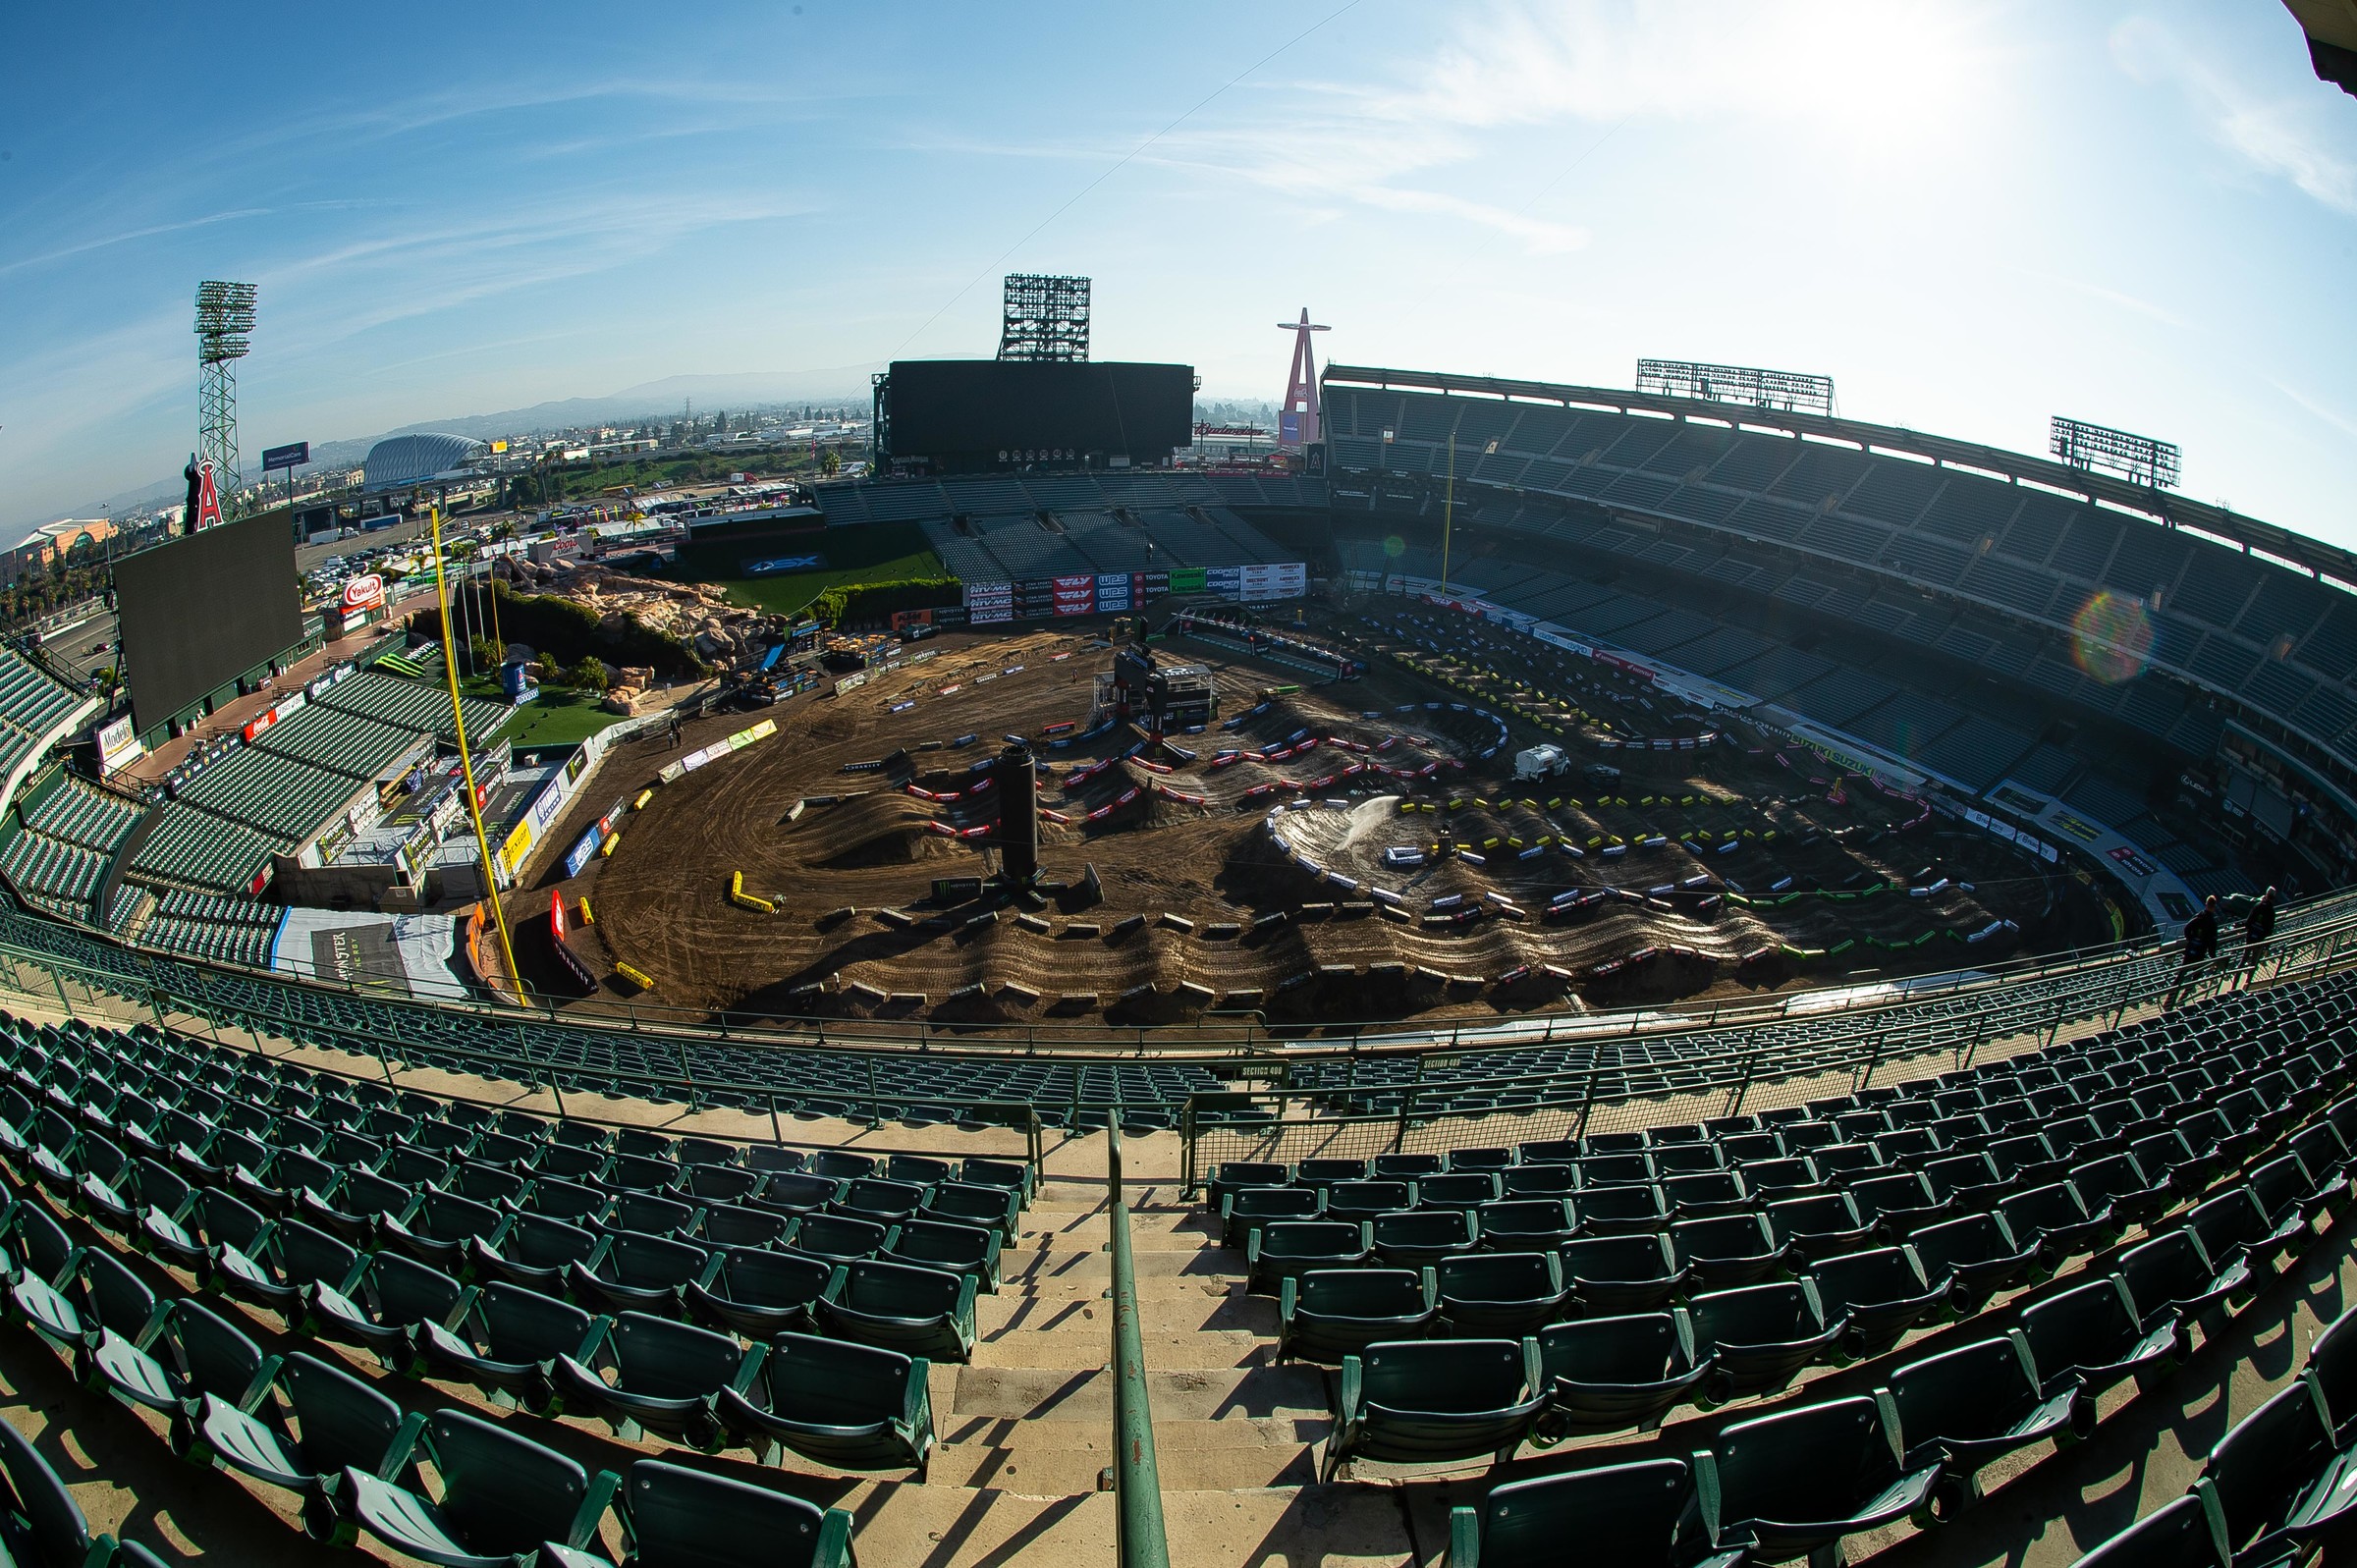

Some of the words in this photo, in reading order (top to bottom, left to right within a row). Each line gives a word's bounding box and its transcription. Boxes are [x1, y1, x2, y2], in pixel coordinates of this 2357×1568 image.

[267, 452, 302, 463] MemorialCare
[196, 450, 223, 531] A
[553, 539, 577, 550] Coors
[1099, 574, 1127, 586] WPS
[1172, 583, 1205, 592] Kawasaki
[352, 580, 377, 599] Yakult
[1099, 586, 1127, 599] WPS
[1099, 599, 1127, 611] WPS
[1486, 612, 1503, 623] WPS
[1512, 621, 1529, 633] WPS
[1601, 654, 1619, 666] HONDA
[1632, 667, 1652, 677] HONDA
[104, 724, 130, 749] Modelo
[1792, 735, 1833, 758] SUZUKI
[1832, 752, 1875, 777] SUZUKI
[484, 773, 502, 794] TOYOTA
[2189, 781, 2213, 797] LEXUS
[507, 828, 528, 862] DUNLOP
[575, 836, 594, 865] WPS
[2121, 859, 2145, 877] TOYOTA
[2132, 856, 2156, 873] TOYOTA
[333, 932, 349, 981] MONSTER
[352, 938, 362, 970] NERGY
[561, 950, 589, 986] OAKLEY
[1424, 1058, 1449, 1068] SECTION
[1449, 1057, 1461, 1067] 409
[1242, 1066, 1269, 1076] SECTION
